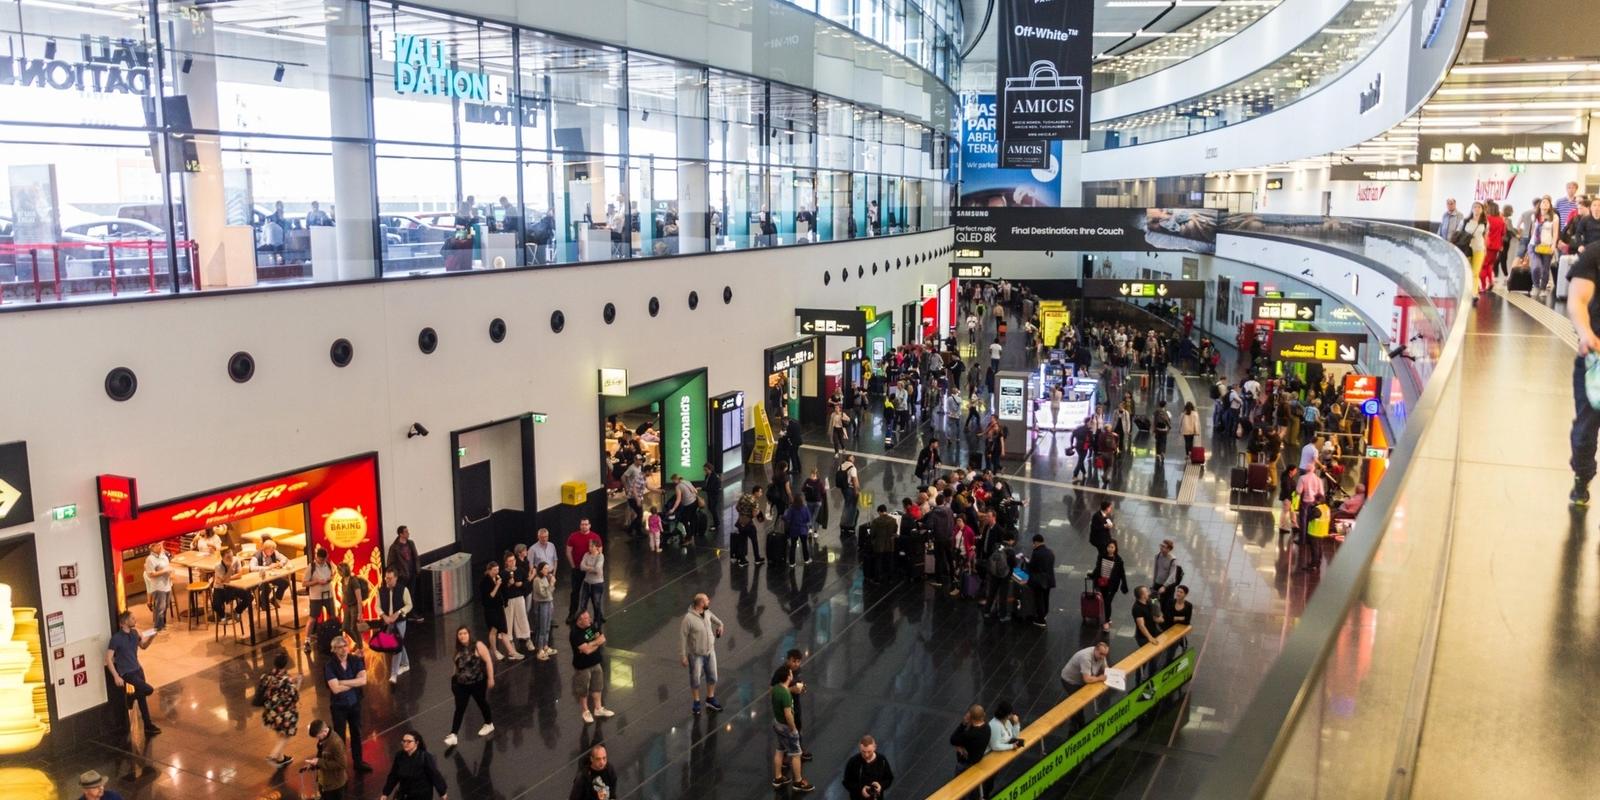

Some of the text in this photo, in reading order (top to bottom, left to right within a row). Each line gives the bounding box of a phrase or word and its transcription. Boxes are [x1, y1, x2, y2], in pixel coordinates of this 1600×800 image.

[395, 33, 446, 68] VALI
[395, 63, 488, 101] DATION
[1012, 99, 1074, 113] AMICIS
[1007, 145, 1042, 154] AMICIS
[977, 225, 996, 233] reality
[1011, 226, 1124, 236] Final Destination: Ihre Couch
[955, 232, 997, 243] QLED 8K
[1293, 344, 1315, 352] Airport
[680, 395, 692, 468] McDonald's
[195, 484, 288, 518] ANKER
[1020, 763, 1054, 795] minutes
[1054, 754, 1064, 766] to
[1064, 734, 1092, 758] Vienna
[1092, 721, 1107, 736] city
